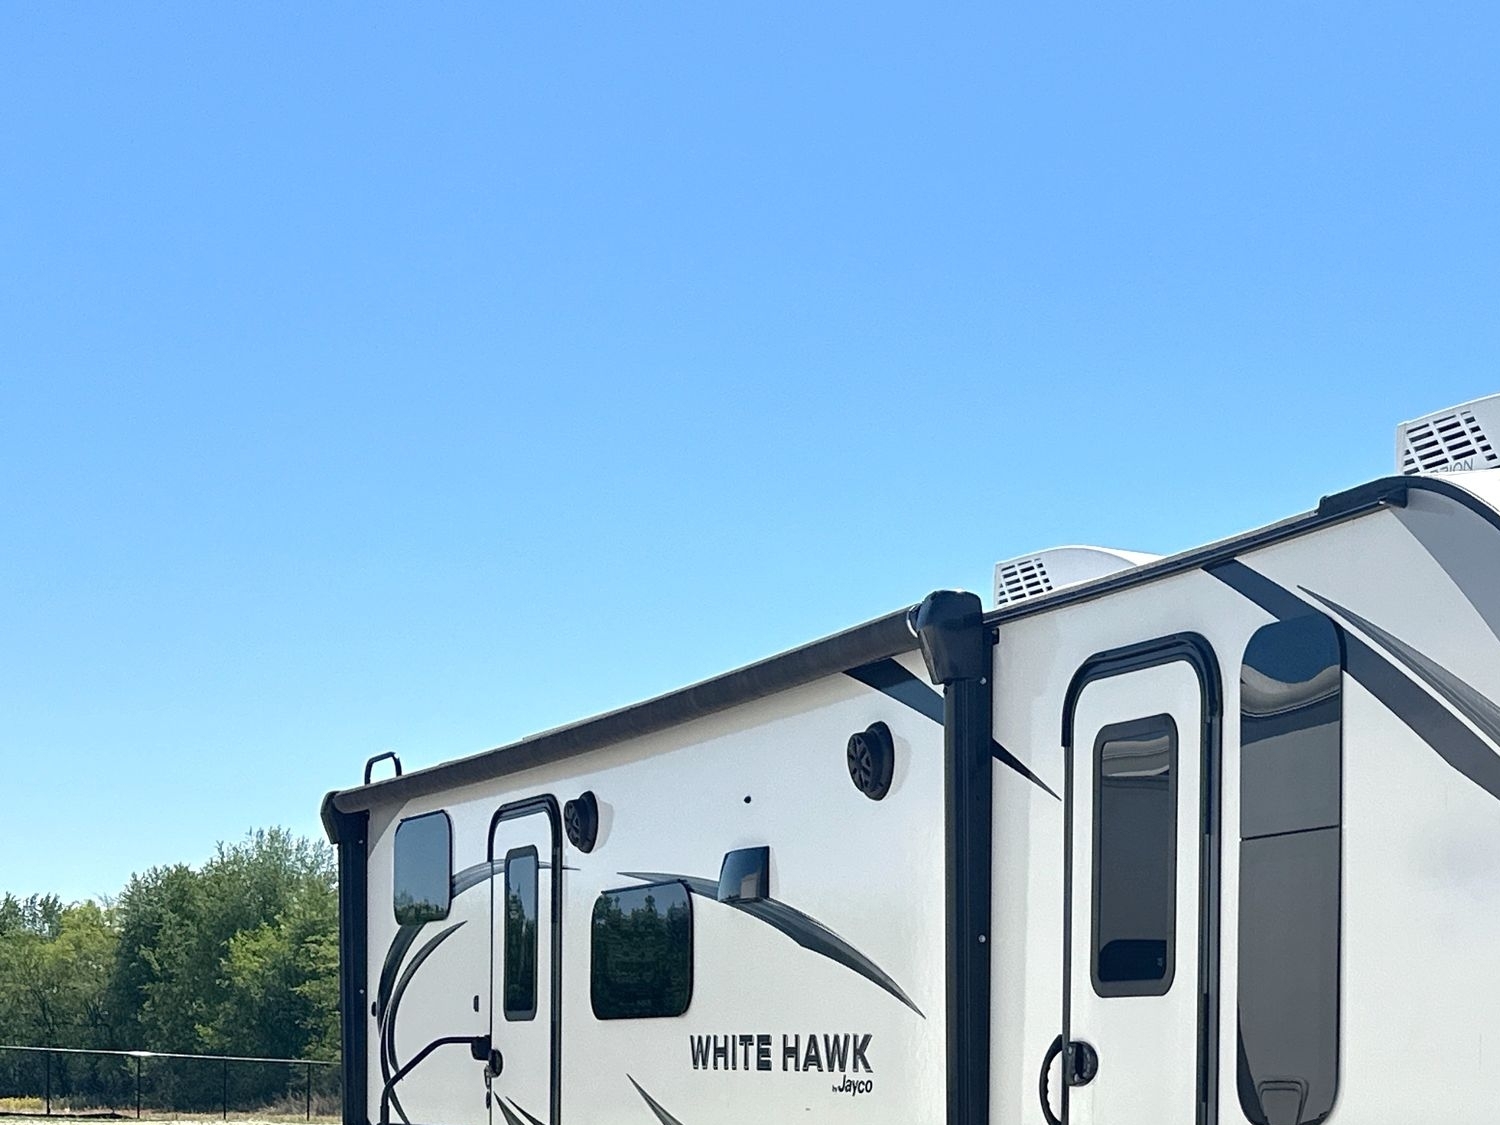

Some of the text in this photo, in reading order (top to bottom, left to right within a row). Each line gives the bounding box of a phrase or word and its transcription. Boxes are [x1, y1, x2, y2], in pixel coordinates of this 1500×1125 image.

[689, 1033, 874, 1073] WHITE HAWK
[838, 1074, 873, 1097] Jayco
